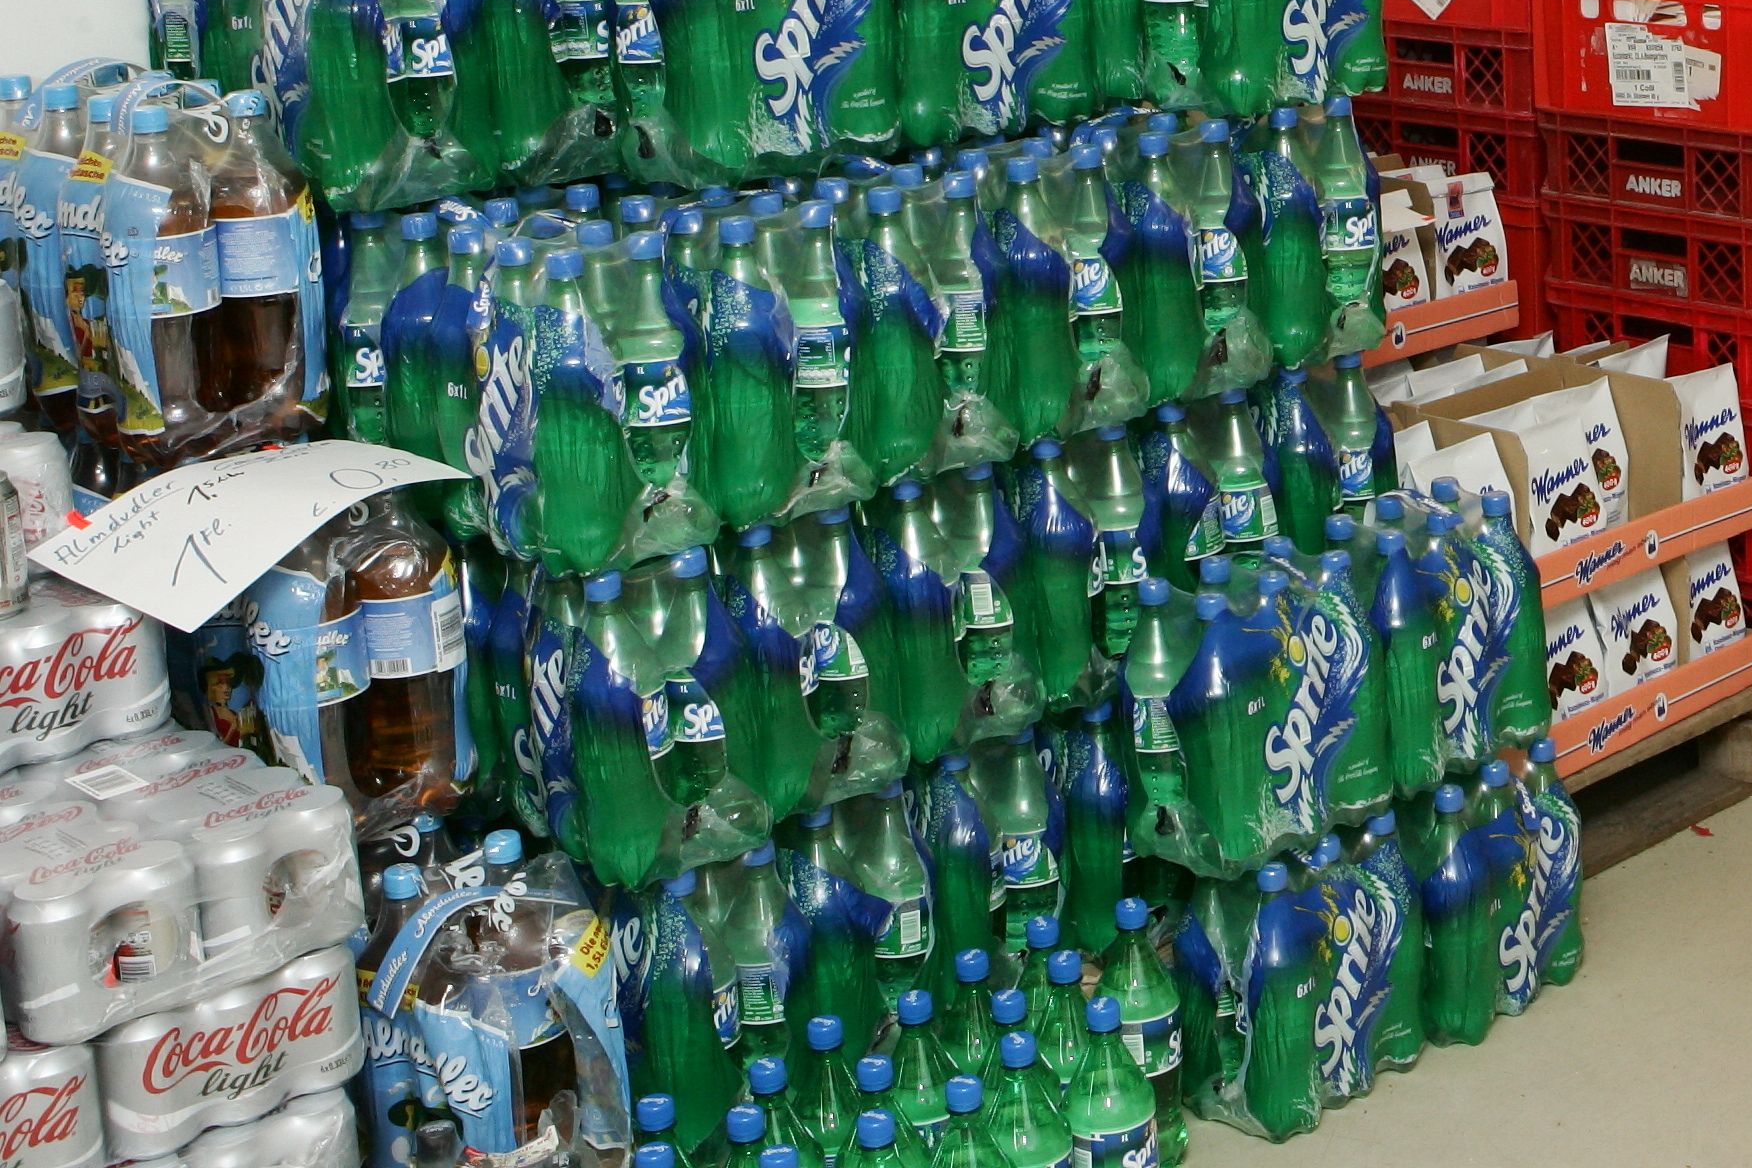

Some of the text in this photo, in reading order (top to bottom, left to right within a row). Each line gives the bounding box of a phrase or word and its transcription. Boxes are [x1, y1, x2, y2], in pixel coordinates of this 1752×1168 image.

[1403, 73, 1453, 95] ANKER
[1626, 174, 1682, 197] ANKER
[1435, 214, 1492, 254] Manner
[1630, 263, 1686, 287] ANKER
[1684, 407, 1738, 450] Manner
[1531, 456, 1589, 506] Manner
[1575, 540, 1625, 585] Manner
[1436, 559, 1492, 734] Sprite
[8, 691, 94, 741] light
[1264, 614, 1338, 804] Sprite
[1588, 704, 1635, 753] Manner
[203, 785, 310, 829] Coca-Cola
[29, 835, 142, 884] Coca-Cola
[1499, 815, 1565, 993] Sprite
[1314, 888, 1377, 1079] Sprite
[143, 972, 340, 1095] Coca-Cola
[199, 1050, 289, 1102] light
